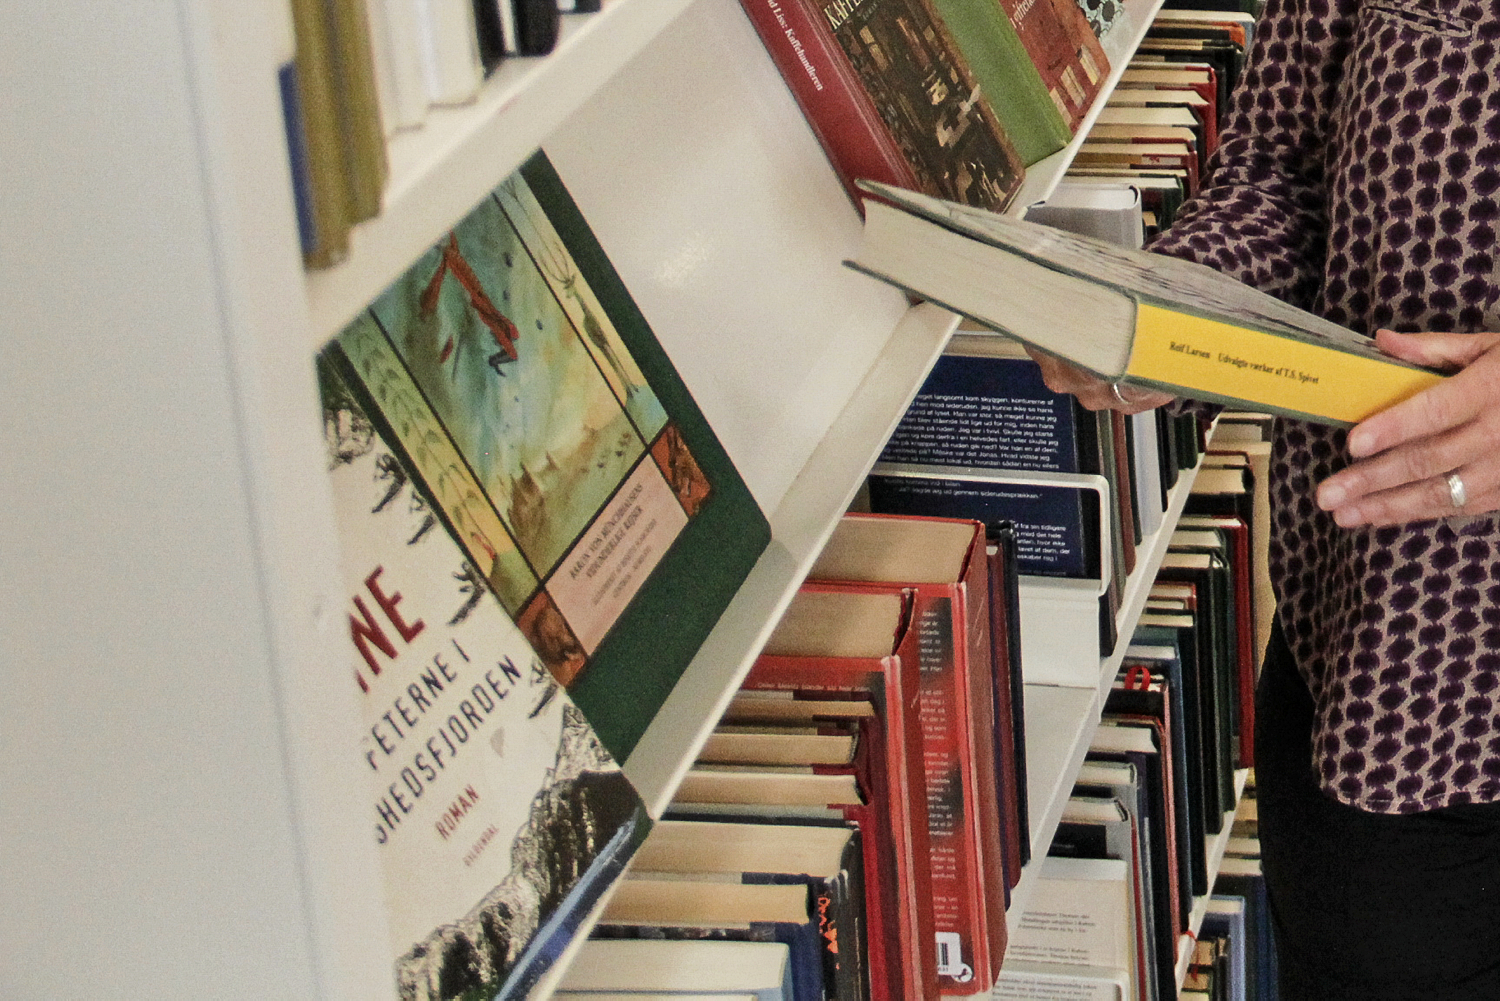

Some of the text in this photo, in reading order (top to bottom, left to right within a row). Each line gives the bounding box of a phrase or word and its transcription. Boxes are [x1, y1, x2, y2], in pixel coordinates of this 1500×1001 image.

[773, 7, 789, 29] Liss:
[784, 27, 824, 92] Kaffehandleren
[1186, 345, 1211, 360] Larsen
[1217, 352, 1249, 369] Udvalgte
[1249, 361, 1275, 374] værker
[1275, 367, 1283, 376] af
[1298, 371, 1320, 385] Spivet
[435, 783, 480, 841] ROMAN
